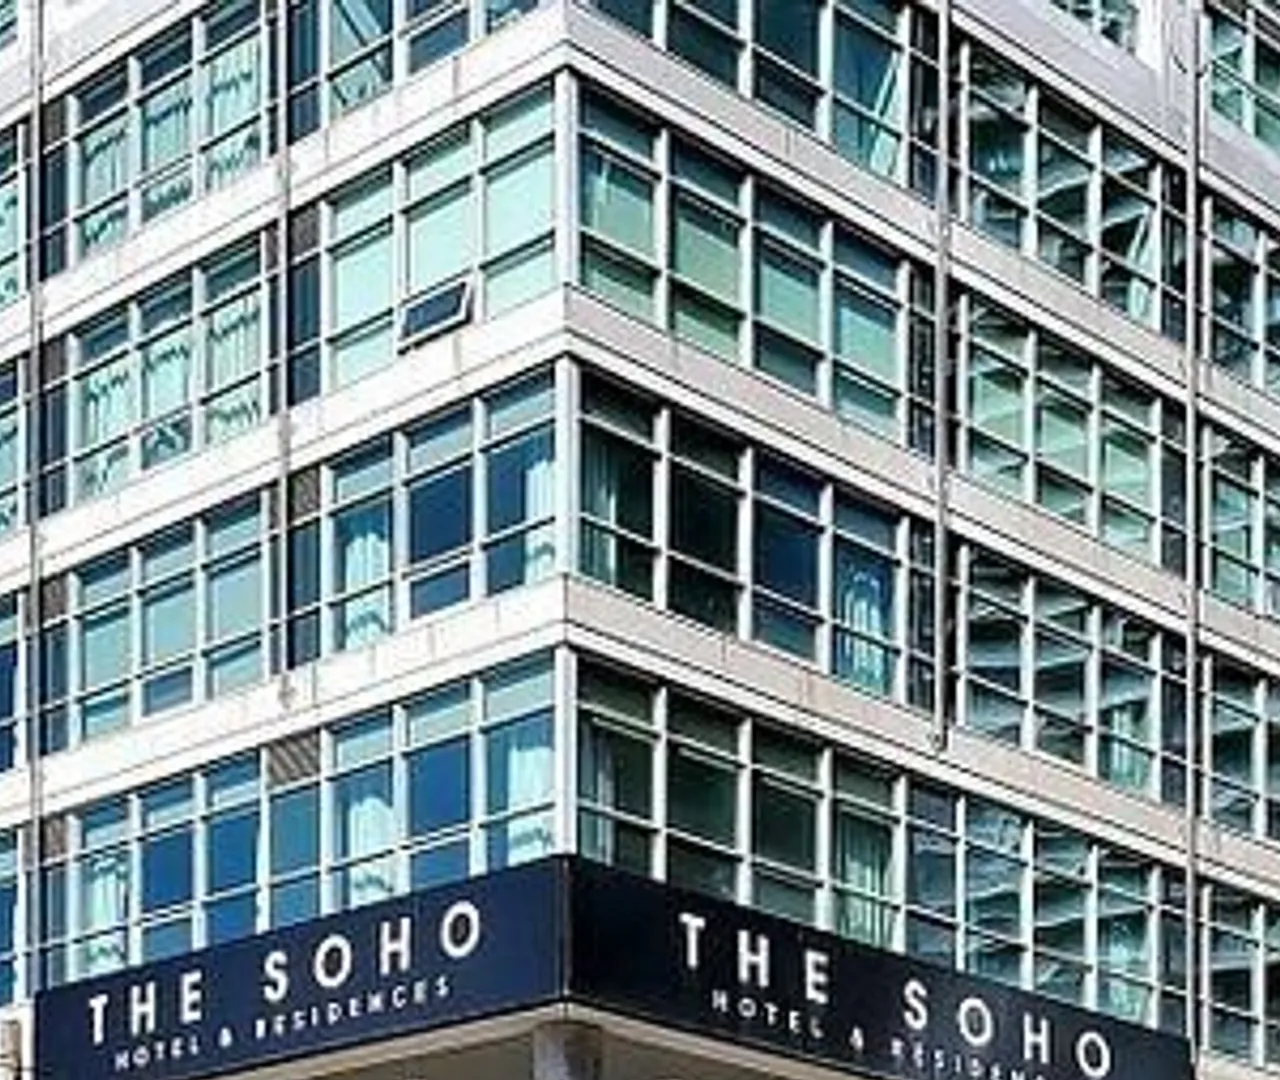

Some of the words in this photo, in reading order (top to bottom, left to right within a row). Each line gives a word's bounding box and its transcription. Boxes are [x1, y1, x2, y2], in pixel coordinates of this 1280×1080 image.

[88, 970, 204, 1046] THE
[262, 901, 481, 1002] SOHO
[114, 1038, 200, 1072] HOTEL
[254, 974, 452, 1041] RESIDENCES
[679, 911, 831, 1006] THE
[902, 979, 1112, 1080] SOHO
[711, 989, 825, 1041] HOTEL
